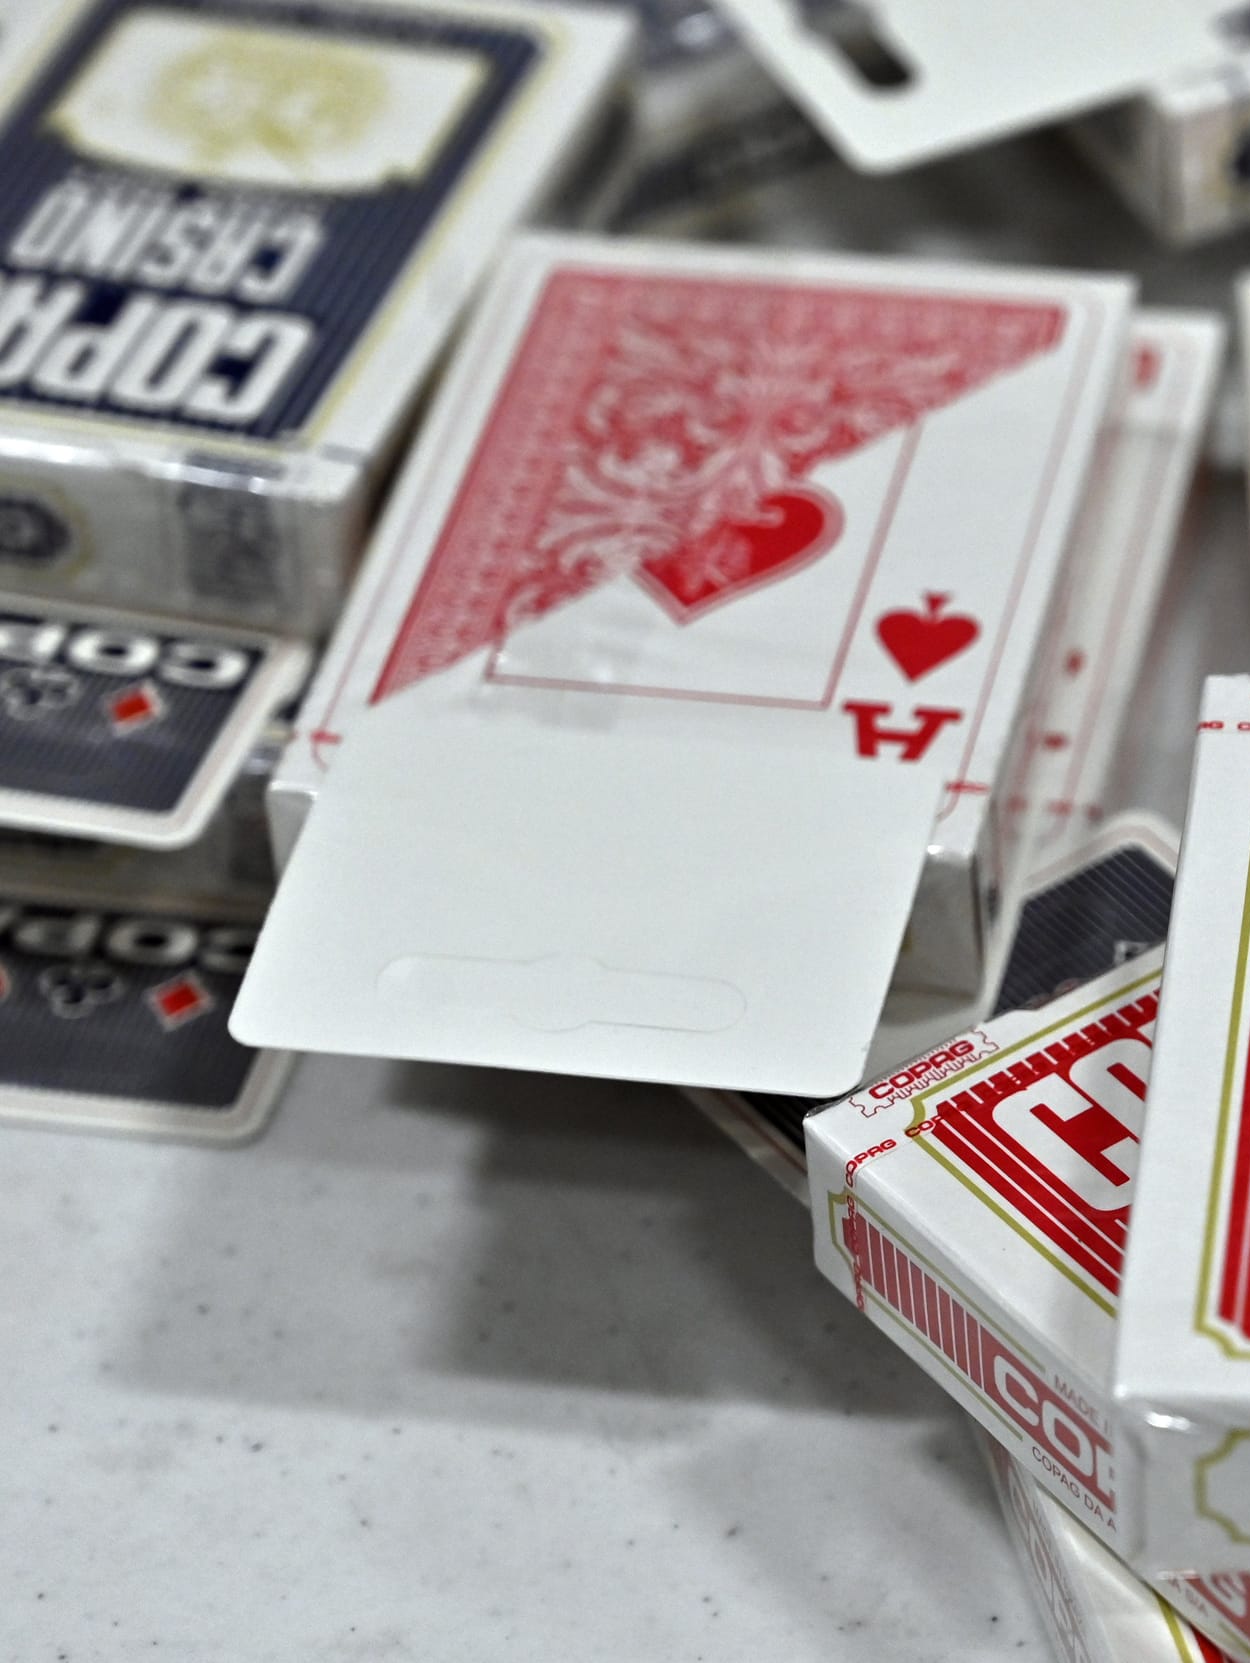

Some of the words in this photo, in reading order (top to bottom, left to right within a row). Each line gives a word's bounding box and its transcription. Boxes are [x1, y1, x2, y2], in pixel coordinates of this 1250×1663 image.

[8, 178, 325, 299] CASINO
[869, 1040, 974, 1099] COPAG
[992, 1020, 1156, 1211] CO
[1053, 1374, 1100, 1428] MADE
[1032, 1446, 1081, 1499] COPAG
[1084, 1494, 1104, 1522] DA
